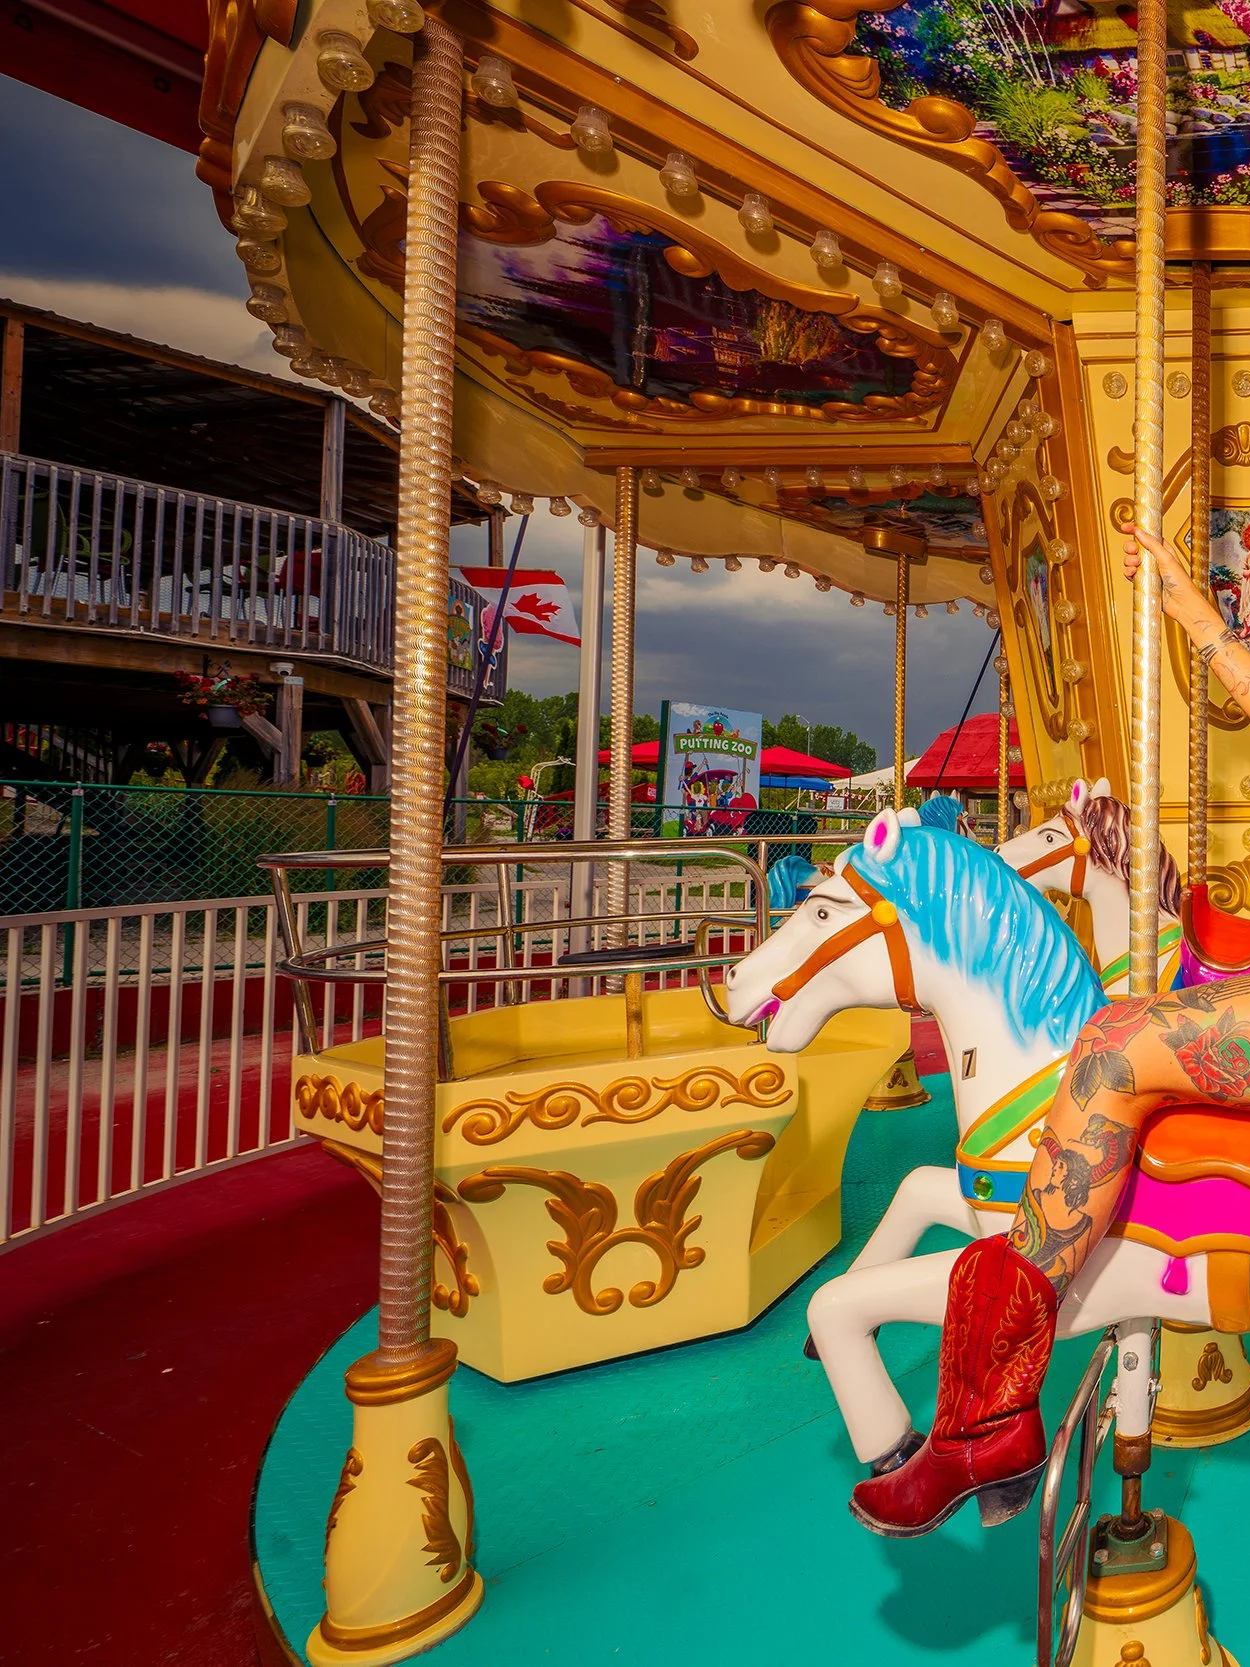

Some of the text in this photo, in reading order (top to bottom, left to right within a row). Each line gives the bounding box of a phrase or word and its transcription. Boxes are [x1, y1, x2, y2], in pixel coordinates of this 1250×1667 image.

[680, 738, 753, 755] PUTTING ZOO
[963, 1049, 975, 1077] 7
